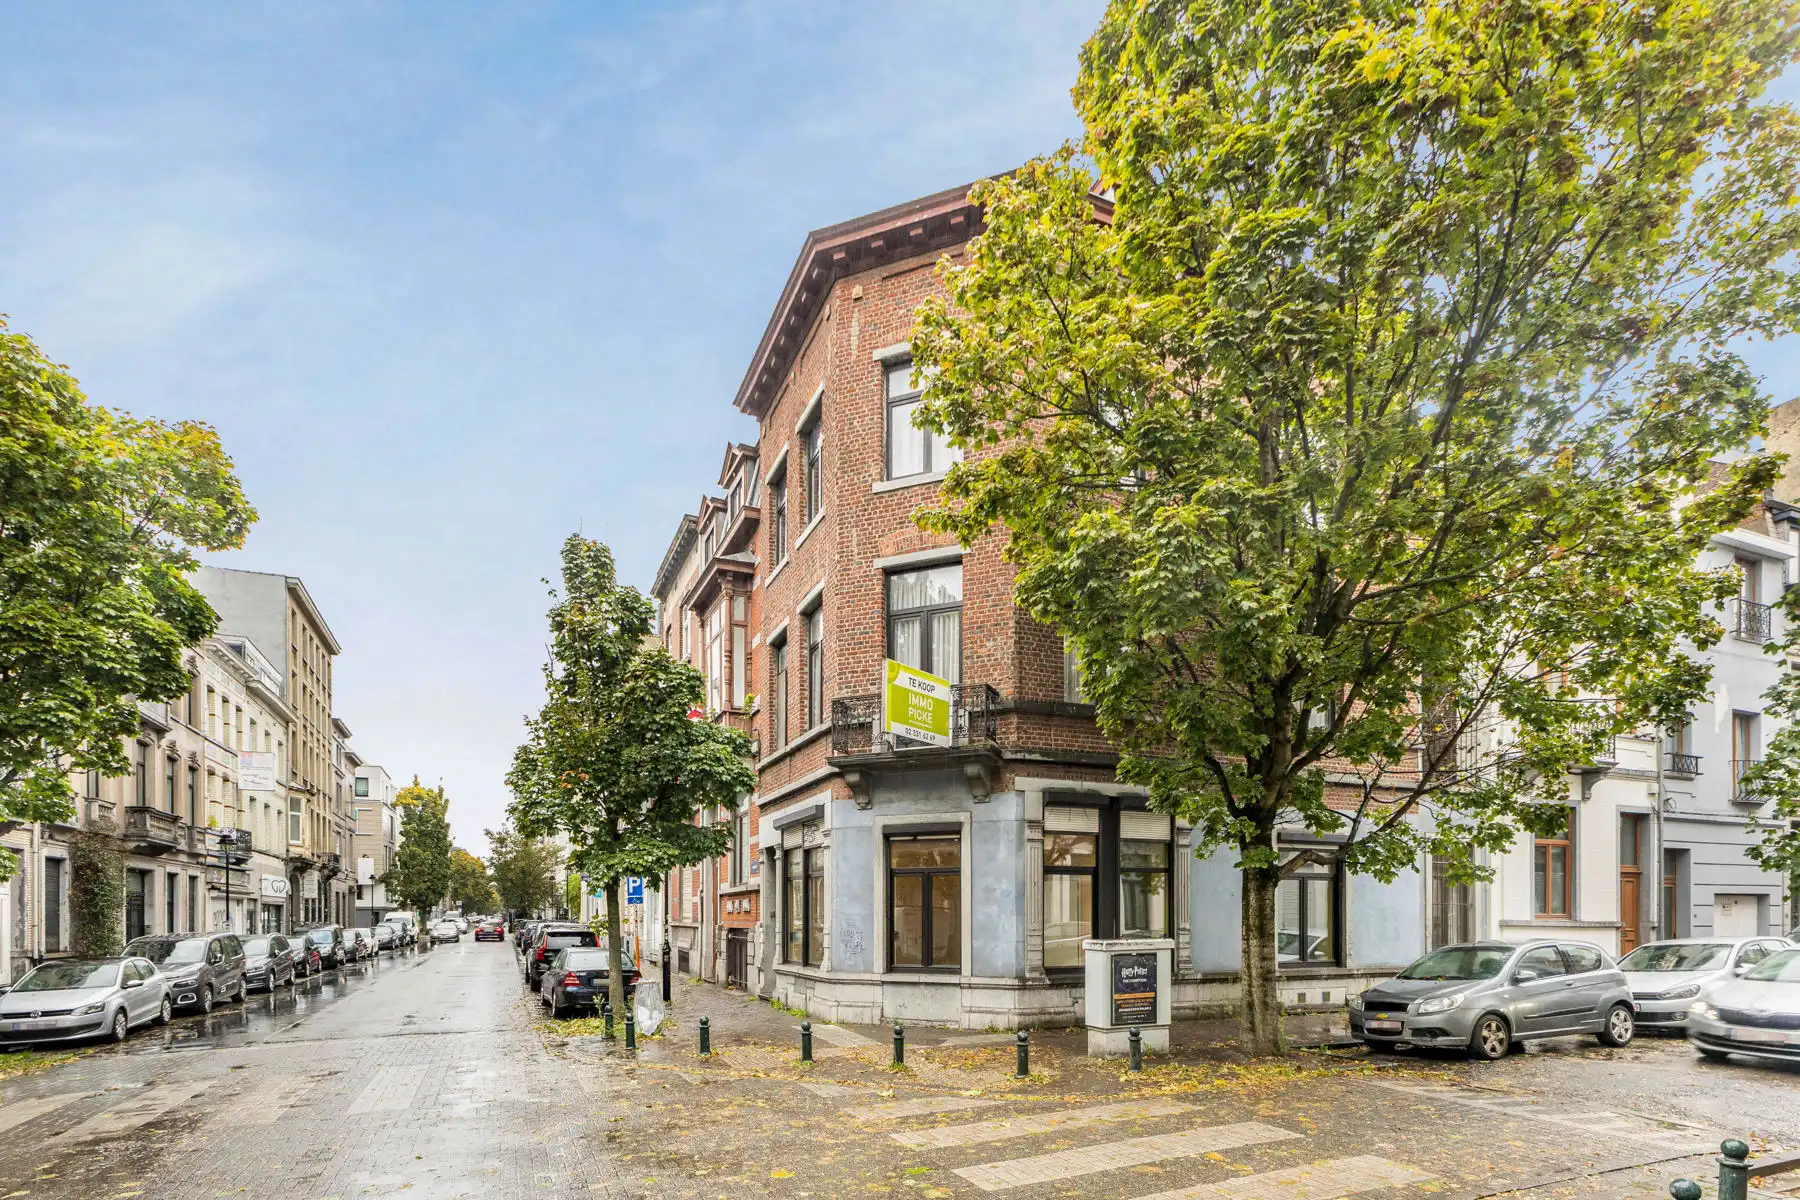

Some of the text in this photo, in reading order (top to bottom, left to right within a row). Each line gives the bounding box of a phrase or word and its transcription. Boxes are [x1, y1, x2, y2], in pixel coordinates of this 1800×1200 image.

[908, 677, 936, 693] TE KOOP
[908, 692, 933, 711] IMMO
[908, 706, 933, 724] PICKE
[629, 877, 640, 893] P
